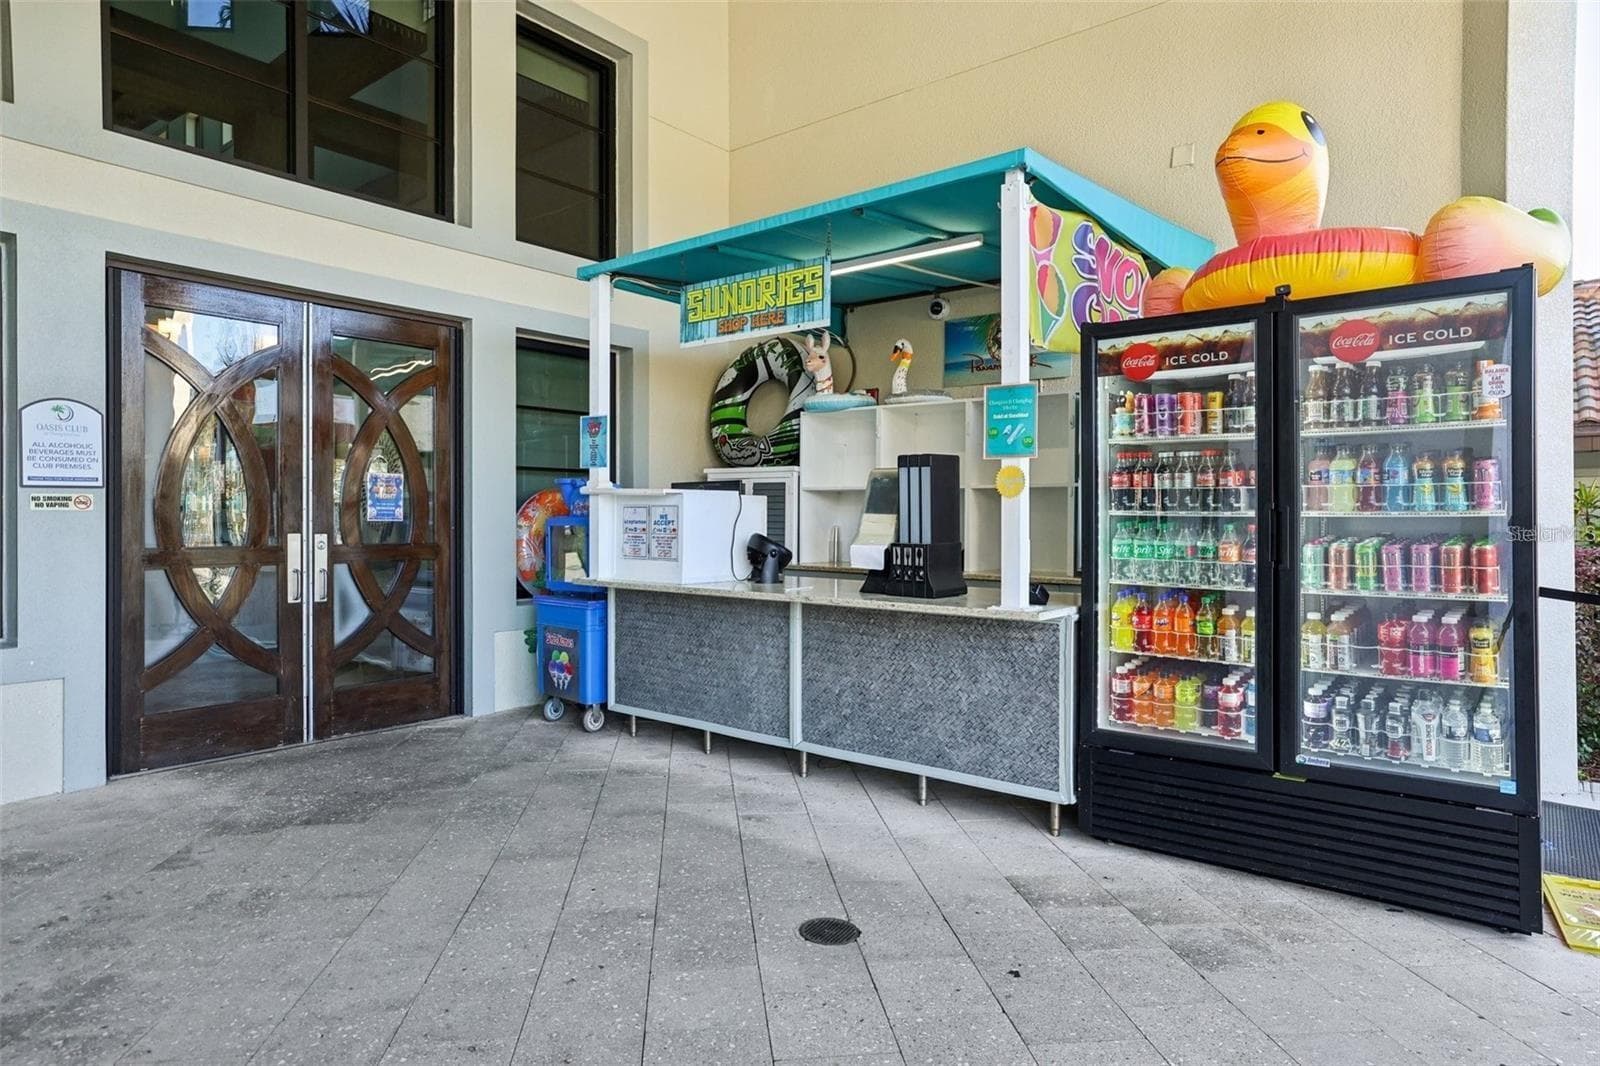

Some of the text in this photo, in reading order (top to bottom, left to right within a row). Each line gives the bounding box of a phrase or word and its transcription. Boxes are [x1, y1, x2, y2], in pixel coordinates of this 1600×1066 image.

[687, 264, 823, 323] SUNDRIES
[719, 310, 785, 333] SHOP HERE
[1332, 332, 1377, 349] Coca-Cola
[1388, 326, 1473, 345] ICE COLD
[1122, 354, 1157, 369] Coca-Cola
[1165, 351, 1229, 366] ICE COLD
[36, 423, 89, 433] OASIS CLUB
[28, 448, 74, 456] BEVERAGES
[48, 442, 93, 450] ALCOHOLIC
